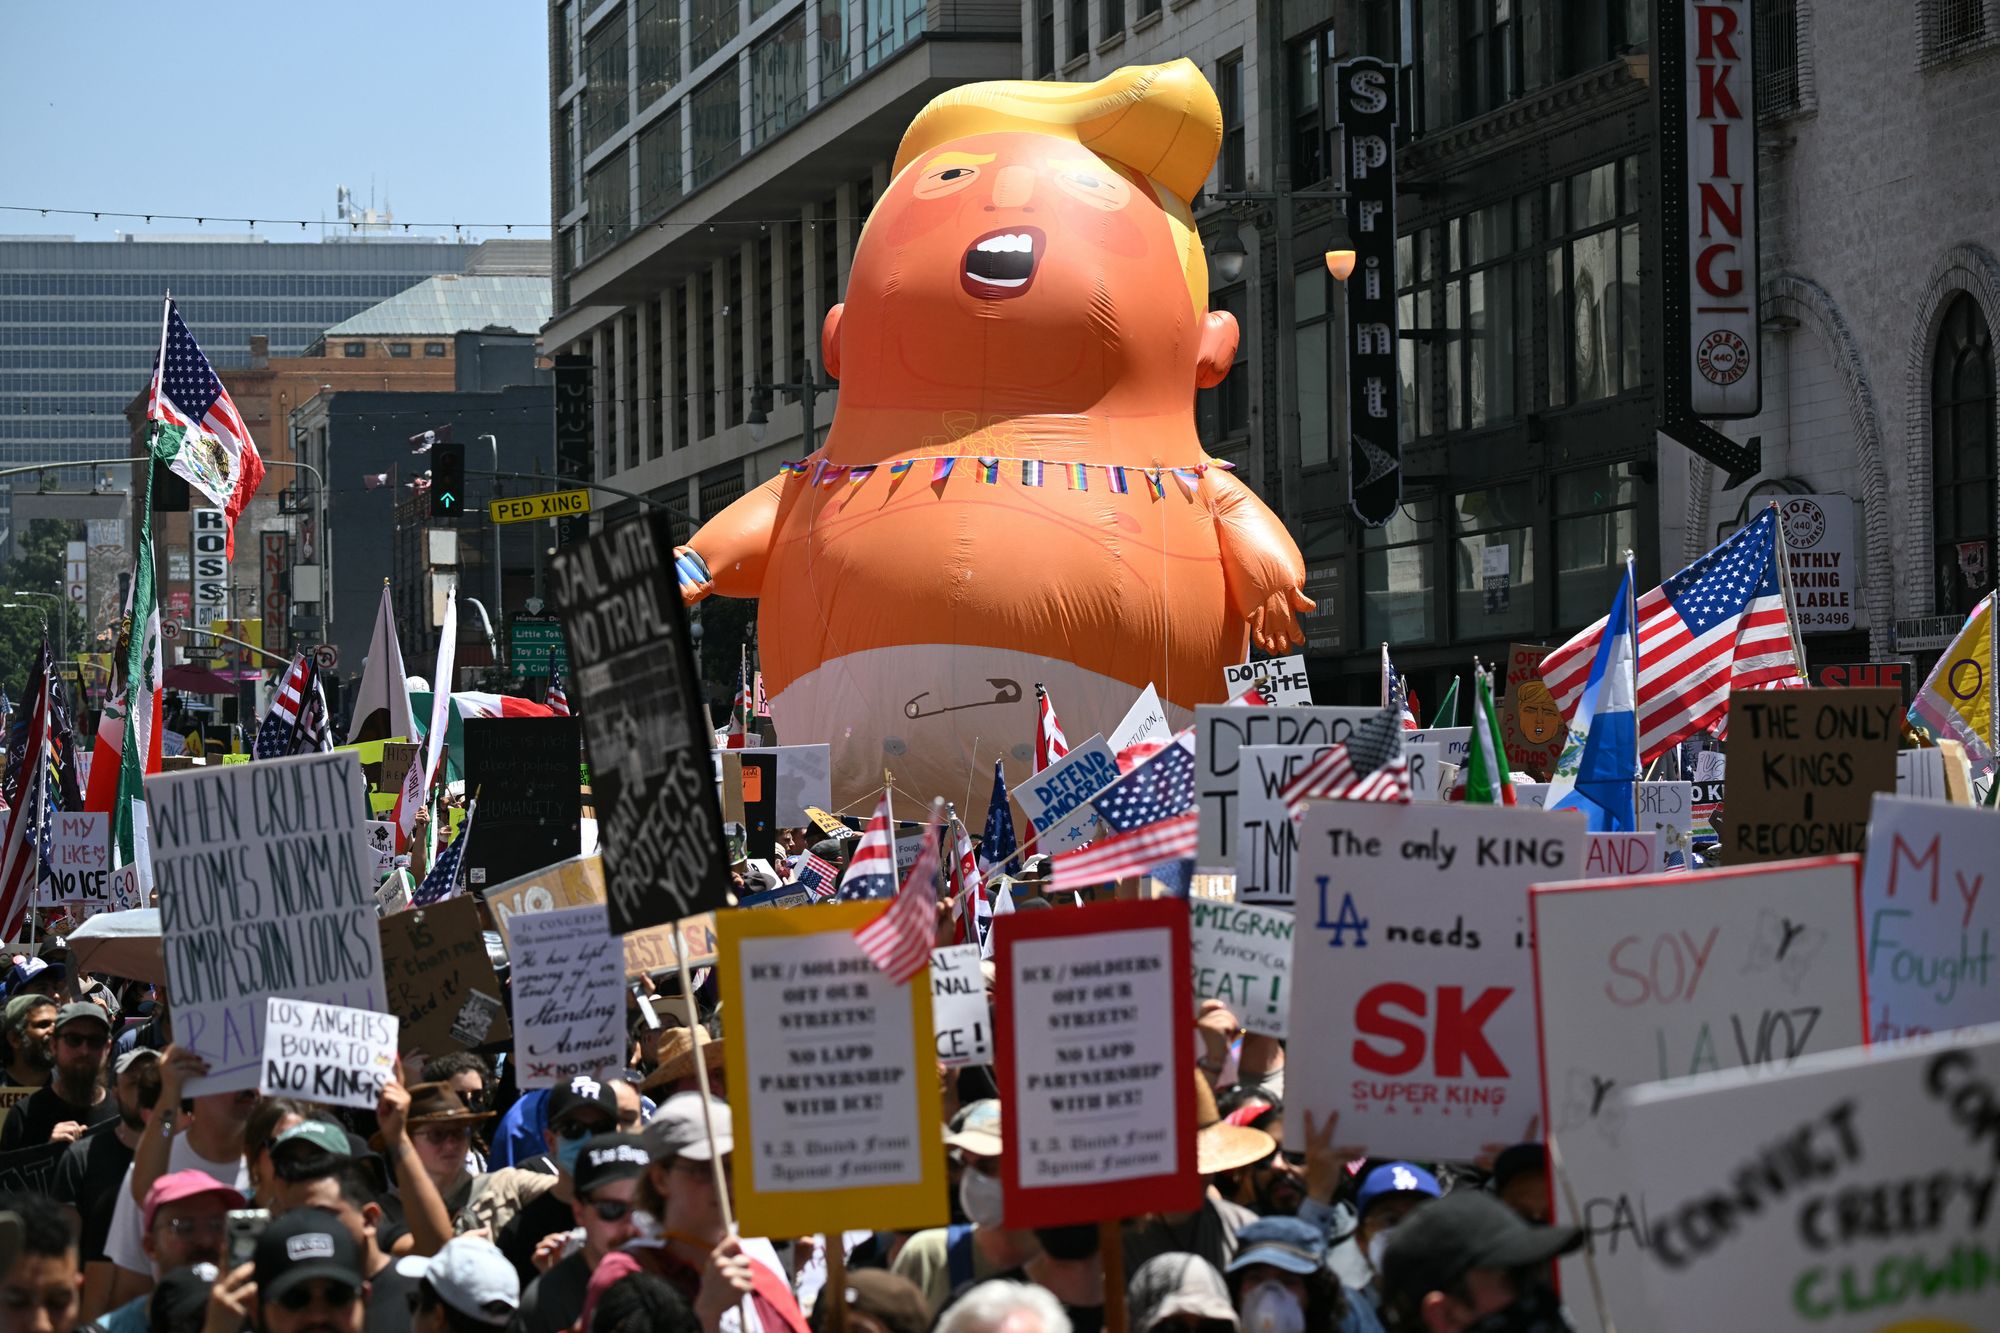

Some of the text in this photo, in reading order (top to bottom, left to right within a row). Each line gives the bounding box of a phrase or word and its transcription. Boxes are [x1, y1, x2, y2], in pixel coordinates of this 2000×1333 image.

[1696, 0, 1743, 298] RKING
[1706, 333, 1743, 350] JOE'S
[1699, 357, 1748, 383] AUTO PARKS
[1713, 354, 1733, 362] 440
[498, 495, 582, 519] PED XING
[1782, 502, 1822, 523] JOE'S
[1793, 521, 1811, 530] 440
[1801, 524, 1823, 547] PARKS
[197, 511, 225, 600] ROSS
[552, 519, 661, 607] JAIL WITH
[1780, 552, 1841, 568] NTHLY
[265, 536, 284, 628] UNION
[516, 630, 564, 639] Little Toky
[569, 577, 672, 668] NO TRIAL
[516, 648, 532, 657] Toy
[1743, 703, 1896, 742] THE ONLY
[1034, 750, 1107, 806] DEFEND
[1763, 750, 1854, 790] KINGS
[148, 758, 355, 849] WHEN CRUELTY
[1805, 792, 1813, 821] I
[62, 817, 95, 839] MY
[609, 751, 702, 926] PROTECTS
[1737, 822, 1866, 856] RECOGNIZ
[1327, 829, 1381, 857] The
[1401, 828, 1457, 871] only
[1476, 836, 1566, 869] KING
[1586, 837, 1649, 873] AND
[51, 870, 108, 901] NO ICE
[153, 832, 379, 934] BECOMES NORMAL
[1888, 832, 1984, 929] My
[497, 886, 553, 930] NO
[1315, 876, 1481, 949] LA needs
[161, 924, 297, 1008] COMPASSION
[299, 908, 374, 989] LOOKS
[1071, 956, 1161, 980] SOLDIERS
[1604, 926, 1721, 1008] SOY
[1868, 906, 1998, 1004] Fought
[269, 1001, 390, 1045] LOS ANGELES
[524, 993, 617, 1035] Standing
[1352, 981, 1515, 1079] SK
[347, 1041, 370, 1066] TO
[789, 1044, 872, 1065] NO LAPD
[1057, 1043, 1134, 1063] NO LAPD
[1656, 1020, 1719, 1088] LA
[1730, 1006, 1822, 1076] VOZ
[267, 1061, 307, 1091] NO
[556, 1053, 618, 1076] NO KINGS
[759, 1067, 904, 1093] PARTNERSHIP
[1027, 1064, 1163, 1090] PARTNERSHIP
[782, 1098, 837, 1116] WITH
[1051, 1095, 1102, 1112] WITH
[1352, 1080, 1506, 1106] SUPER KING
